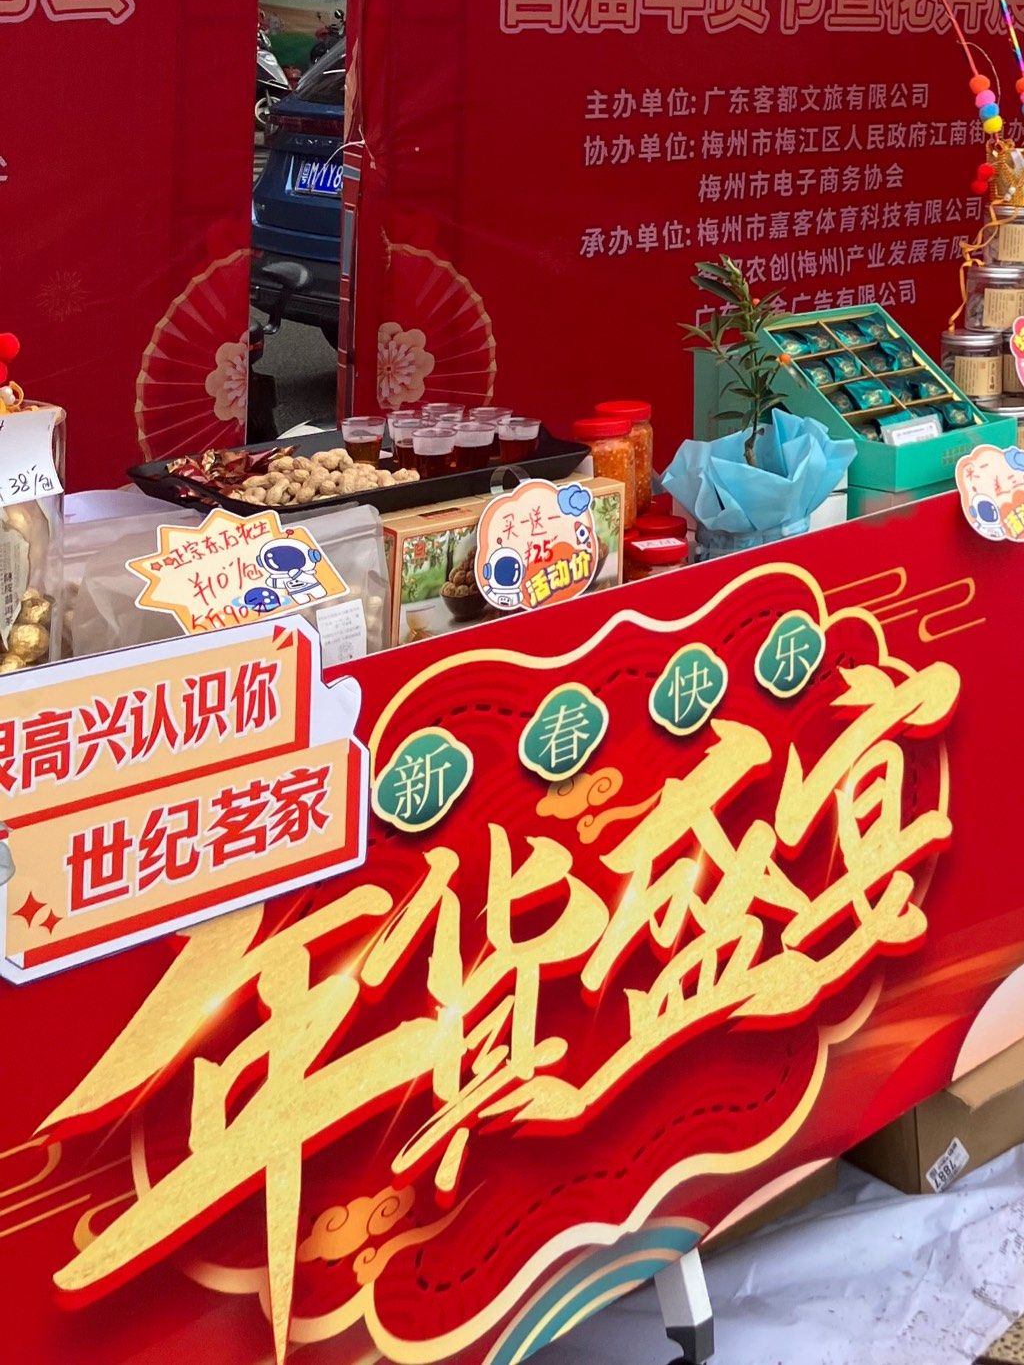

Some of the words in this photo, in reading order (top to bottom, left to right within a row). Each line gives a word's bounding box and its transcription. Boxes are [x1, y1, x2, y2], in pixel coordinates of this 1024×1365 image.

[585, 84, 929, 119] 主办单位:广东客都文旅有限公司
[698, 163, 904, 203] 梅州市电子商务协会
[525, 549, 592, 607] 活动价
[393, 623, 810, 823] 新春快乐
[66, 765, 332, 912] 世纪茗家
